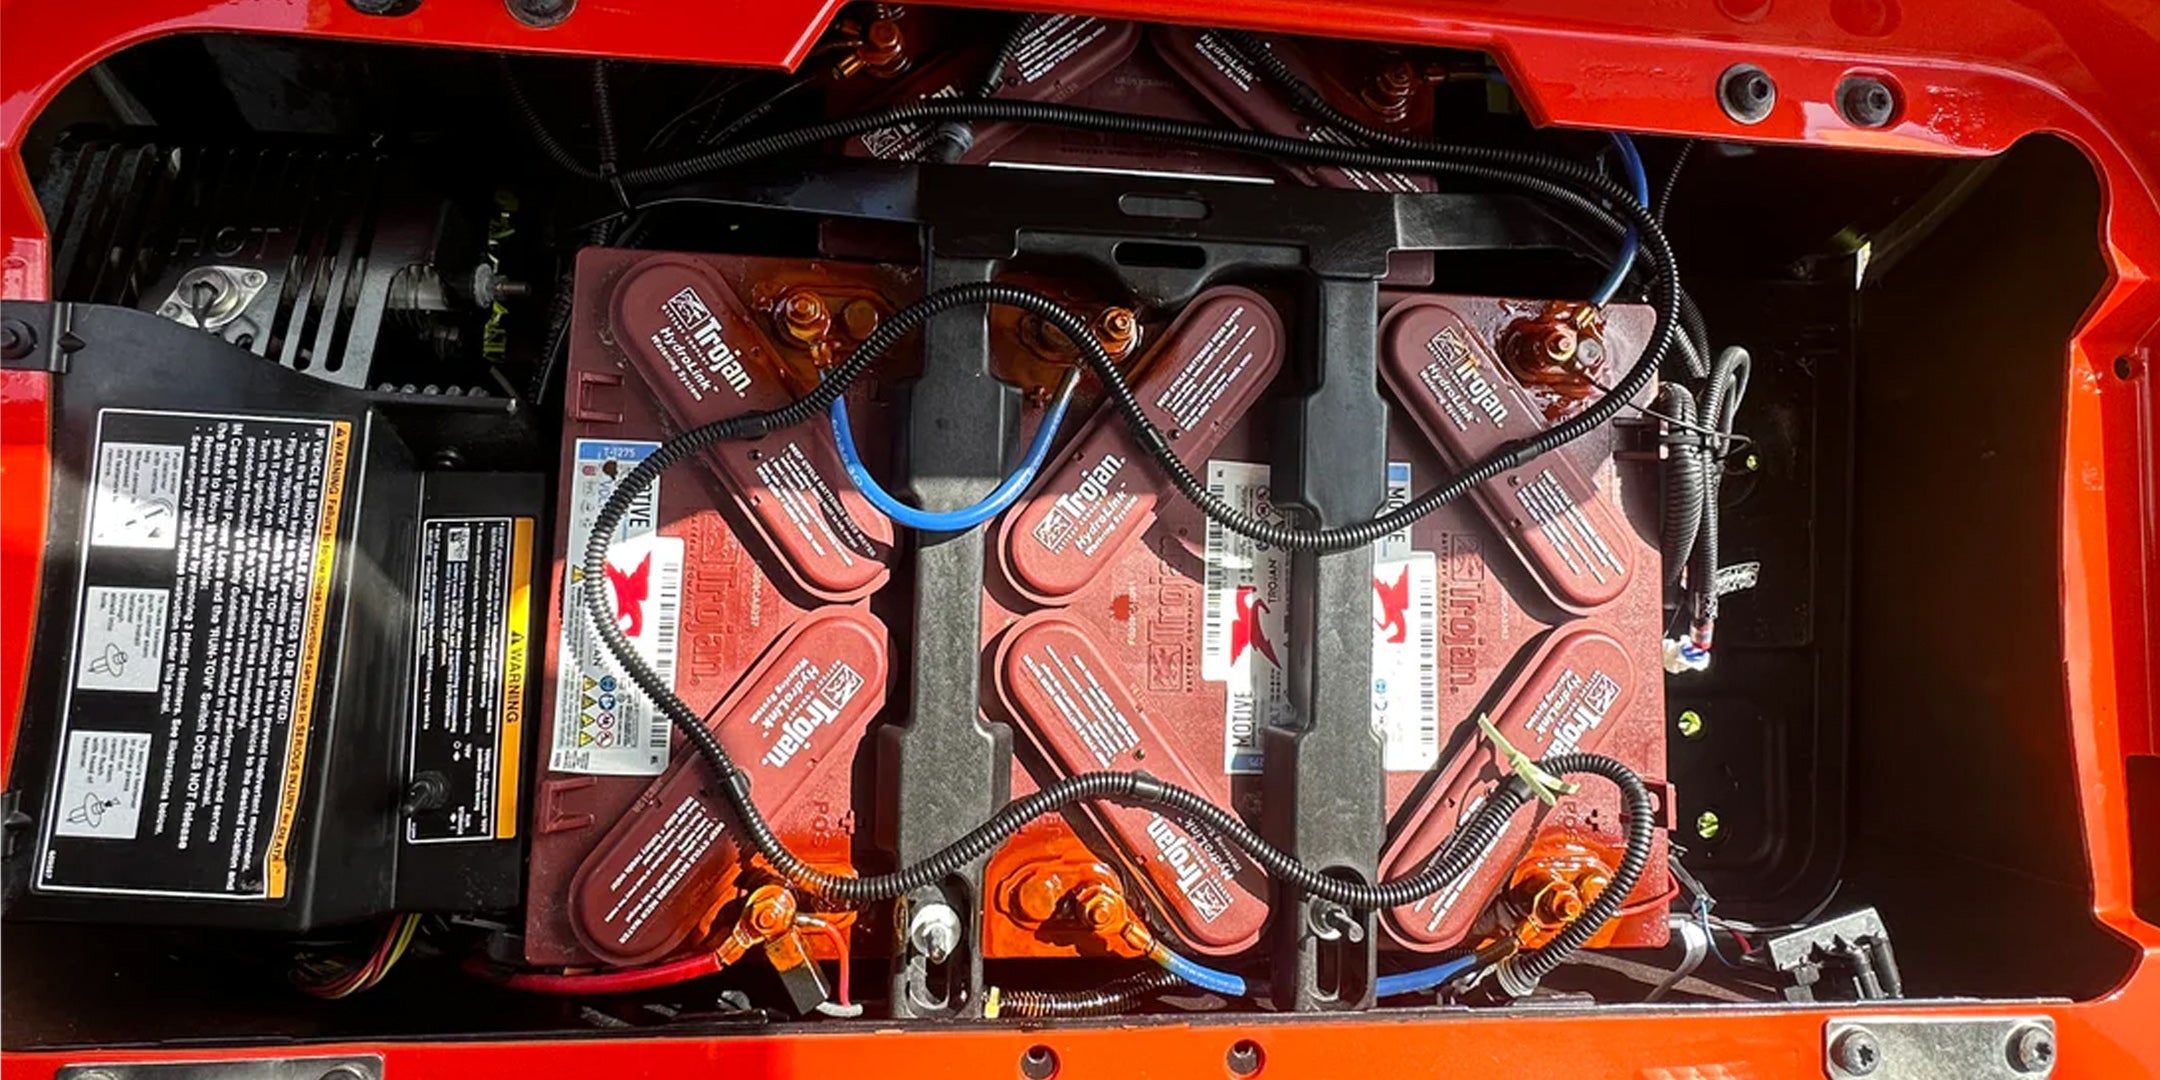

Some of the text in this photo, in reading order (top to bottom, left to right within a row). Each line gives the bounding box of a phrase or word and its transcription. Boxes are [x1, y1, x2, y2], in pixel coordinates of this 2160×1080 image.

[171, 226, 283, 260] HOT
[215, 421, 228, 441] the
[211, 441, 227, 476] Brake
[227, 436, 242, 467] Case
[307, 438, 325, 486] VEHICLE
[207, 490, 221, 523] Move
[222, 480, 237, 511] Total
[203, 523, 217, 544] the
[217, 510, 233, 548] Power
[295, 500, 316, 573] INOPERABLE
[198, 543, 216, 591] Vehicle:
[214, 548, 230, 579] Loss
[1268, 558, 1276, 603] TROJAN
[212, 580, 225, 603] and
[293, 574, 306, 599] AND
[210, 604, 223, 624] the
[287, 600, 302, 640] NEEDS
[275, 677, 292, 725] MOVED:
[505, 649, 522, 724] WARNING
[195, 690, 212, 733] Switch
[1232, 690, 1252, 746] MOTIVE
[190, 733, 207, 770] DOES
[185, 771, 201, 799] NOT
[177, 800, 196, 850] Release
